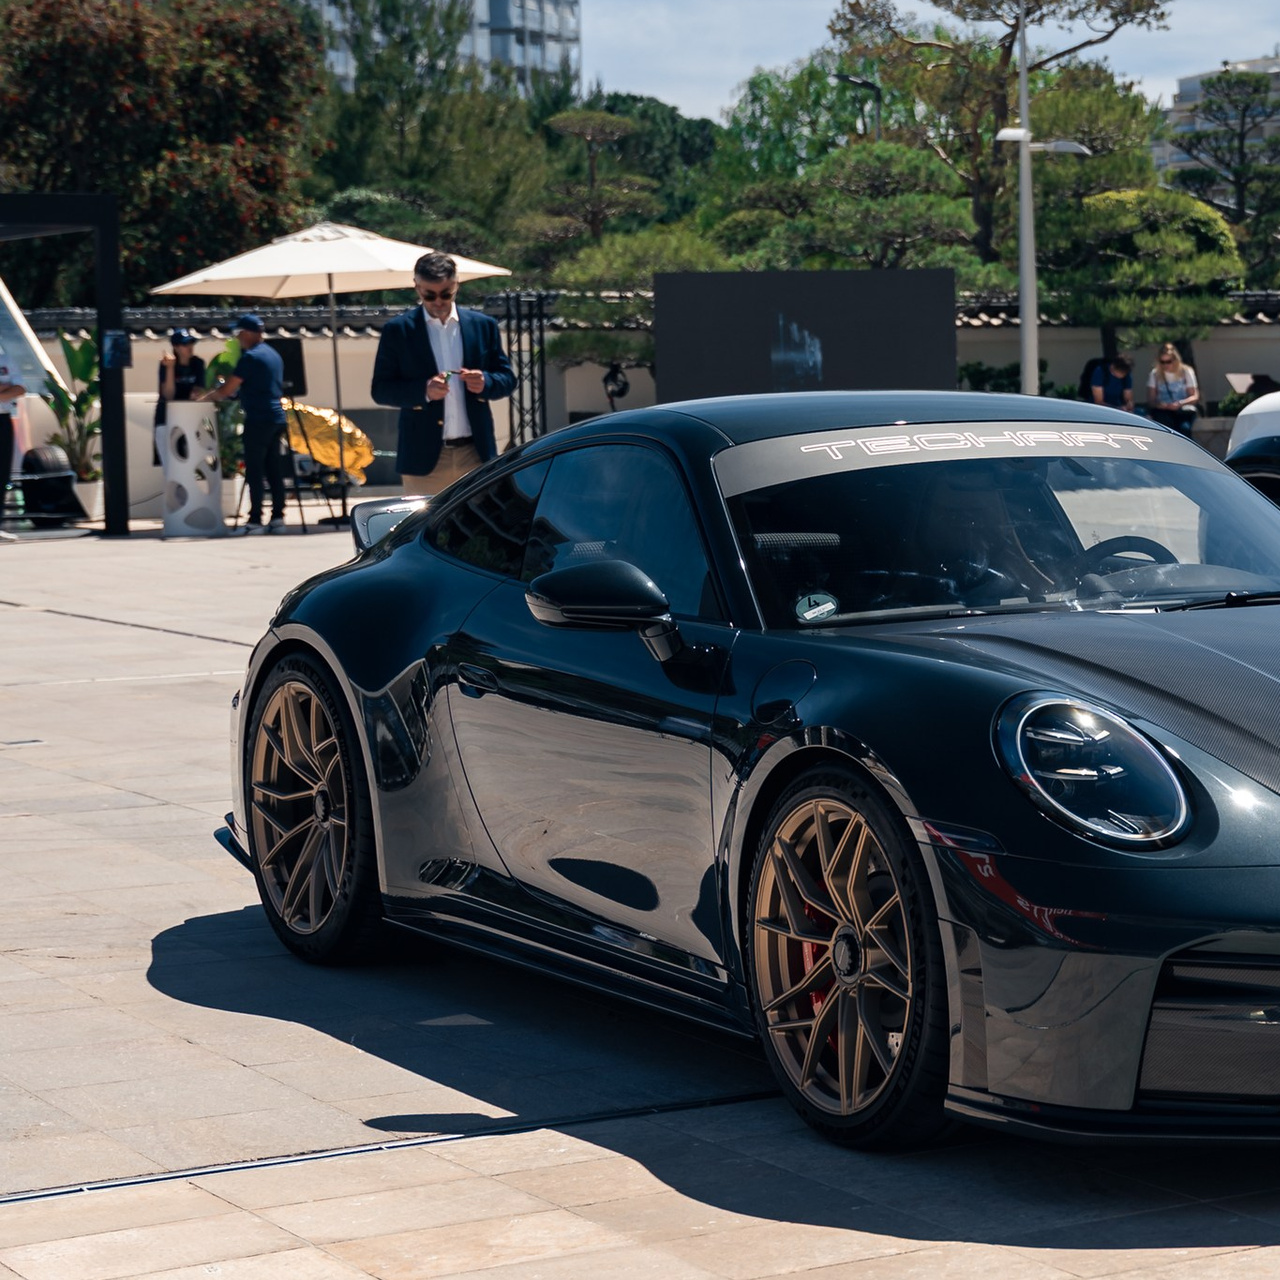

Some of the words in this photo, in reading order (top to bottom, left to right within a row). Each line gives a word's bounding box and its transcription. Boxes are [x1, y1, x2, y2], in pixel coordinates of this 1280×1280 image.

[800, 431, 1153, 460] TECHART
[807, 596, 820, 608] 4
[897, 997, 925, 1092] MICHELIN
